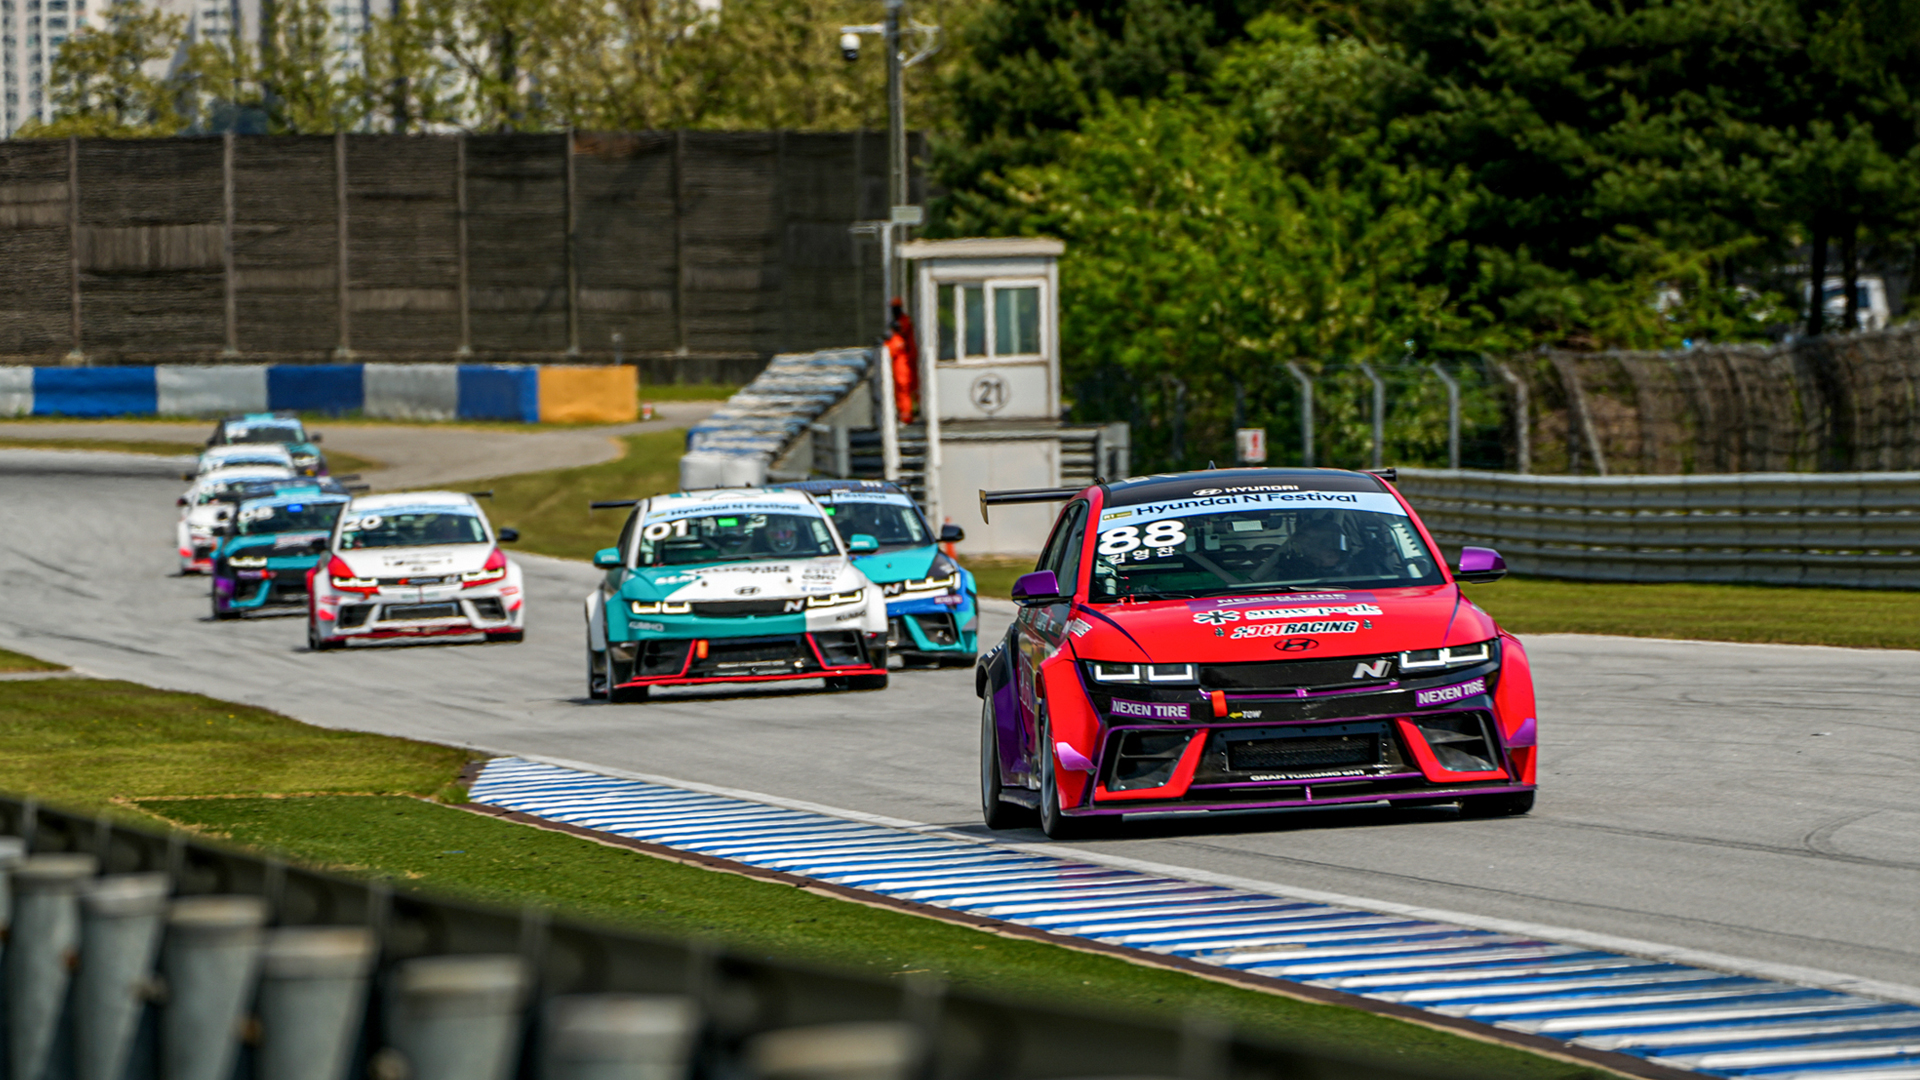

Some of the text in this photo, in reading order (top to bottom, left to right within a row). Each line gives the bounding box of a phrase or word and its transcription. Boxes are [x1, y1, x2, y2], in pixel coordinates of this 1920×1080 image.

[979, 380, 1002, 404] 21
[1225, 485, 1299, 494] HYUNDAI
[671, 504, 730, 516] Hyundai
[747, 502, 801, 511] Festival
[1136, 494, 1237, 516] Hyundai
[1244, 494, 1260, 503] N
[1268, 492, 1358, 503] Festival
[644, 519, 688, 541] 01
[1098, 520, 1187, 556] 88
[1108, 547, 1175, 565] 김영찬
[1246, 604, 1382, 619] snow peak
[1418, 679, 1485, 704] NEXEN TIRE
[1112, 700, 1187, 717] NEXEN TIRE
[1242, 710, 1262, 719] TOW
[1287, 770, 1342, 779] TURISMO
